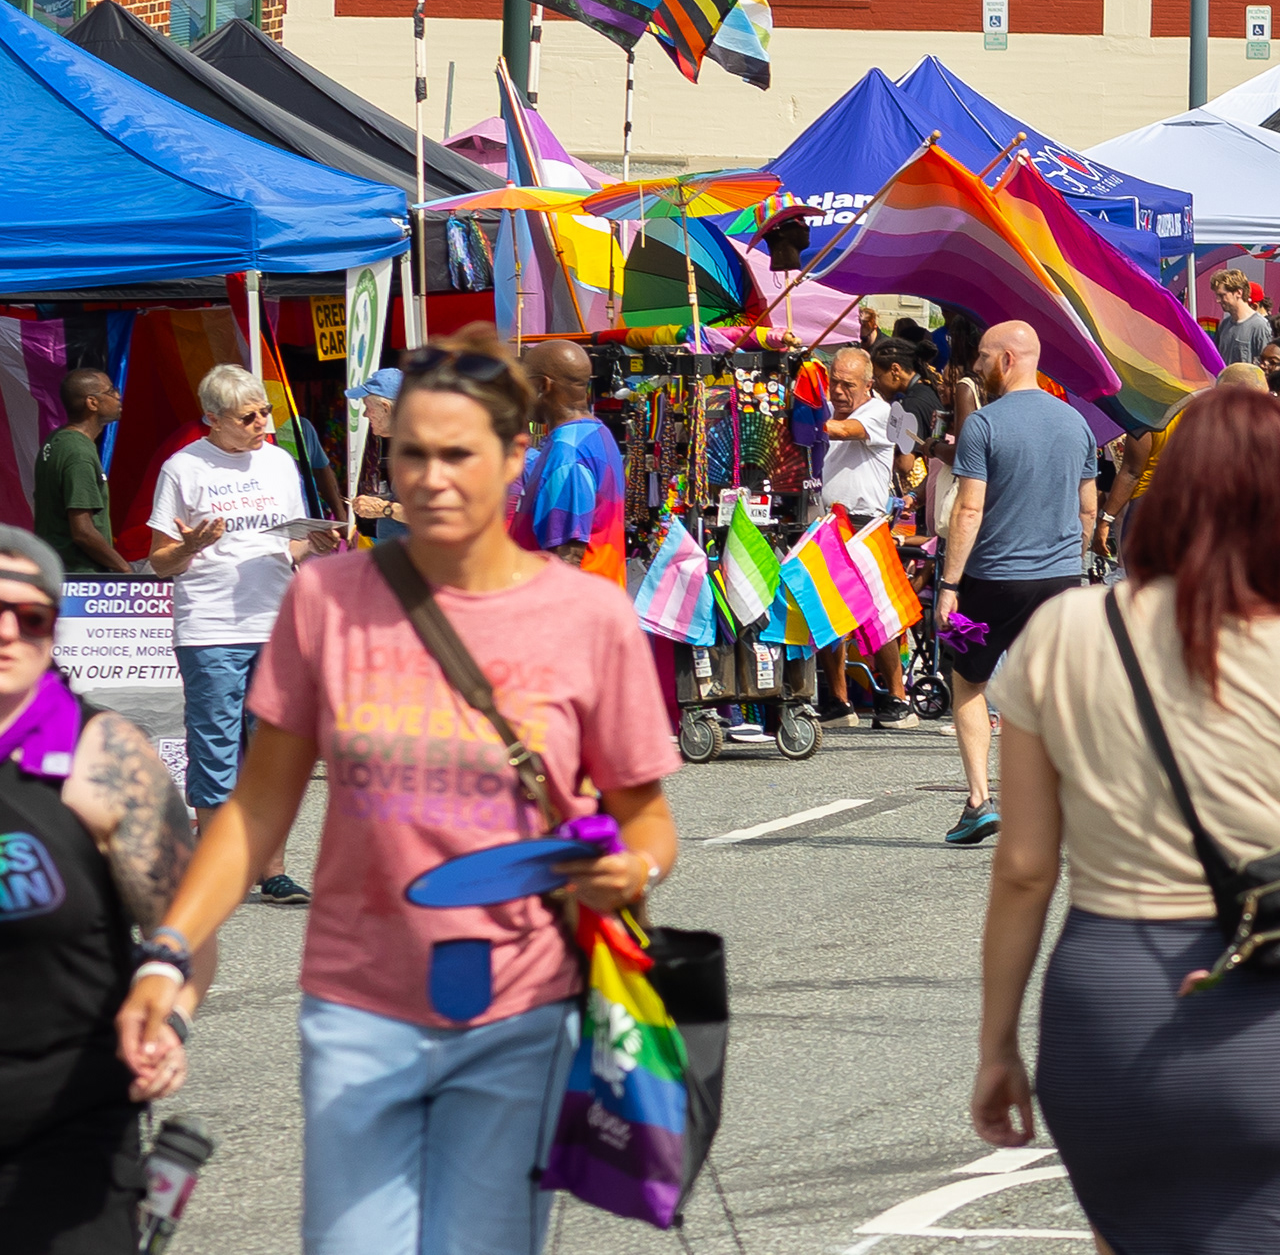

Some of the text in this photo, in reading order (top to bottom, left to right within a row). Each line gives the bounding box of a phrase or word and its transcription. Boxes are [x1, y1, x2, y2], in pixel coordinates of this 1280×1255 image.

[315, 303, 347, 329] CRED
[320, 329, 348, 356] CAR
[207, 478, 264, 498] Not Left
[803, 478, 822, 490] DIVA
[211, 495, 280, 514] Not Right
[225, 513, 288, 533] ORWARD
[62, 582, 174, 597] IRED OF POLIT
[85, 599, 174, 614] GRIDLOCK
[86, 628, 174, 638] VOTERS NEED
[52, 646, 173, 658] ORE CHOICE, MORE
[60, 665, 83, 679] GN
[86, 665, 123, 679] OUR
[336, 701, 424, 737] LOVE
[428, 710, 454, 739] IS
[332, 734, 418, 766] LOVE
[340, 762, 416, 792] LOVE
